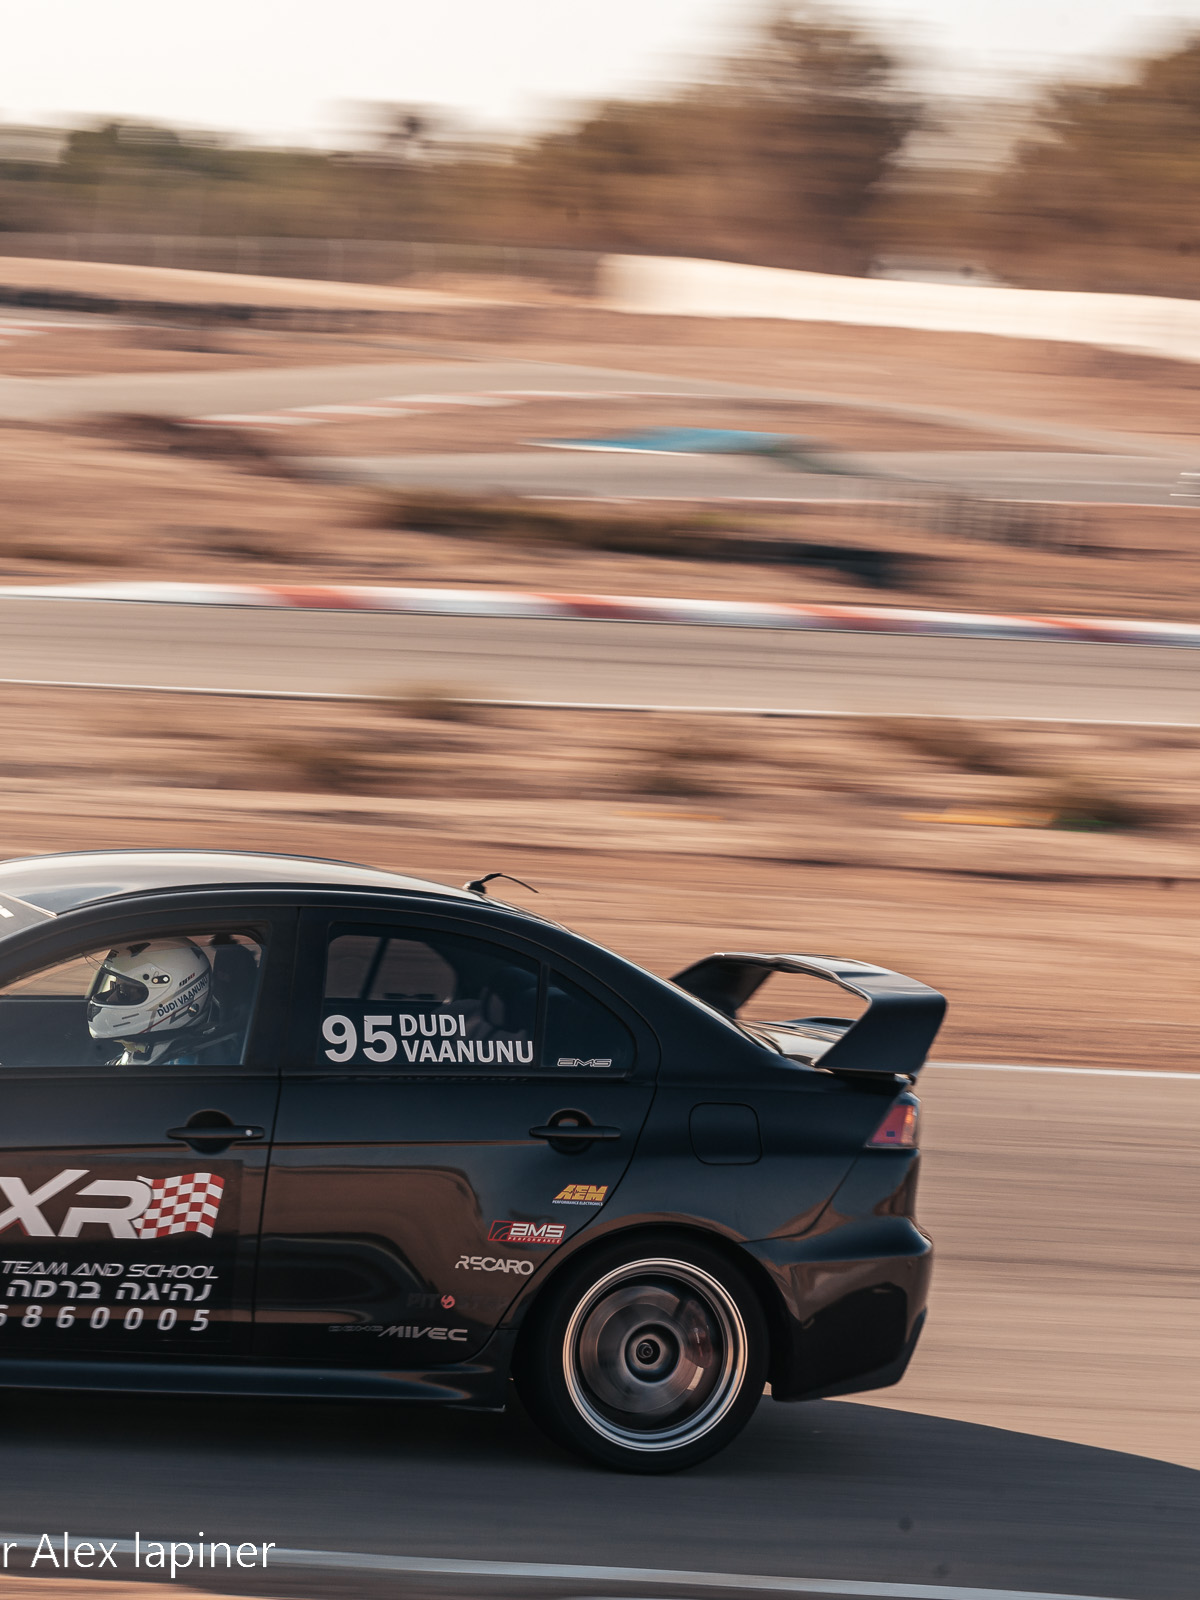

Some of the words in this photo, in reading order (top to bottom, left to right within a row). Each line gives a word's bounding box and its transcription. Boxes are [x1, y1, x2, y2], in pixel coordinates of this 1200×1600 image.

[157, 1000, 178, 1017] DUDI
[400, 1014, 466, 1037] DUDI
[321, 1014, 398, 1063] 95
[401, 1040, 534, 1063] VAANUNU
[553, 1184, 608, 1201] AEM
[1, 1260, 69, 1276] TEAM
[71, 1262, 125, 1277] AND
[125, 1263, 219, 1279] SCHOOL
[455, 1255, 534, 1276] RECARO
[114, 1281, 213, 1301] נהיגה
[378, 1325, 468, 1341] MIVEC
